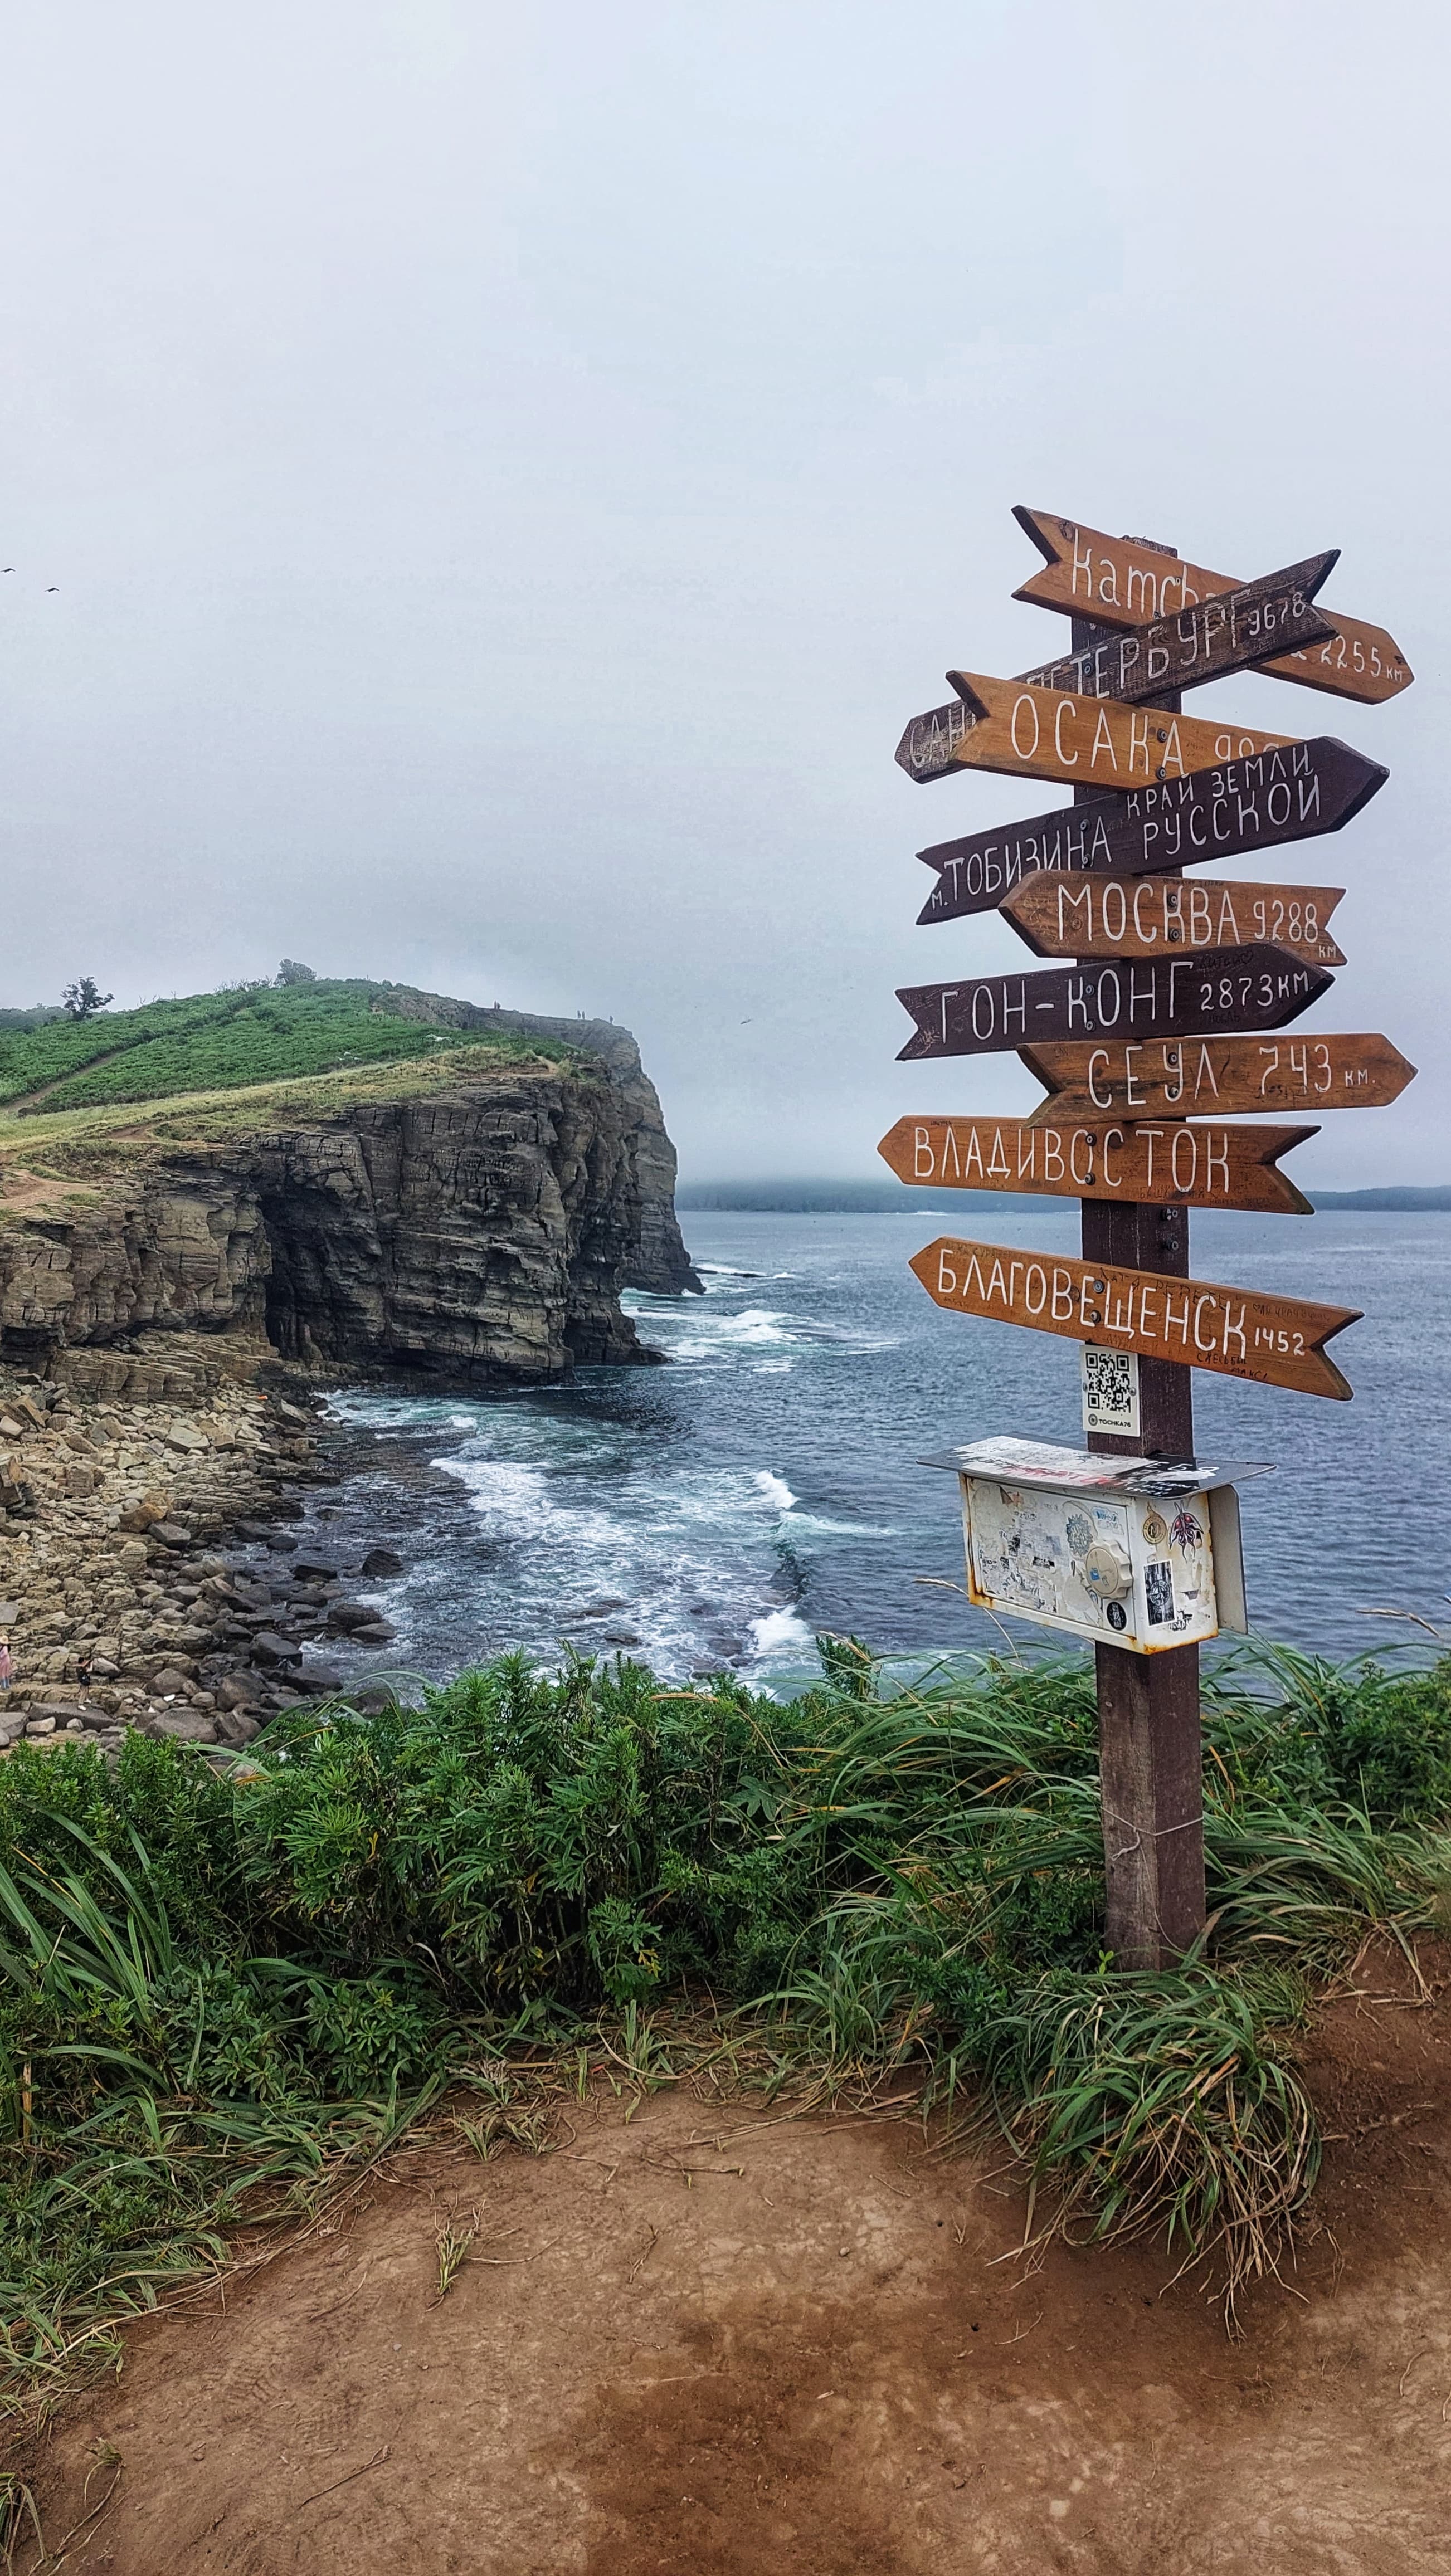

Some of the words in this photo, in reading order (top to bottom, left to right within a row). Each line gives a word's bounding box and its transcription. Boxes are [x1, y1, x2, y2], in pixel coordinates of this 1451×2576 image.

[910, 704, 976, 768] САН
[1248, 592, 1306, 636] 9678
[1321, 635, 1382, 677] 2255
[1011, 694, 1187, 777] ОСАКА
[1215, 734, 1279, 762] 90
[1128, 773, 1194, 819] КРАЙ
[1211, 744, 1309, 797] ЗЕМЛИ
[1144, 768, 1320, 860] РУССКОЙ
[944, 816, 1113, 902] ТОБИЗИНА
[1058, 882, 1240, 945] МОСКВА
[1254, 900, 1318, 943] 9288
[1089, 1043, 1219, 1109] СЕУЛ
[1259, 1043, 1332, 1095] 743
[914, 1126, 1229, 1193] ВЛАДИВОСТОК
[938, 1248, 1246, 1359] БЛАГОВЕЩЕНСК
[1254, 1327, 1306, 1357] 1452
